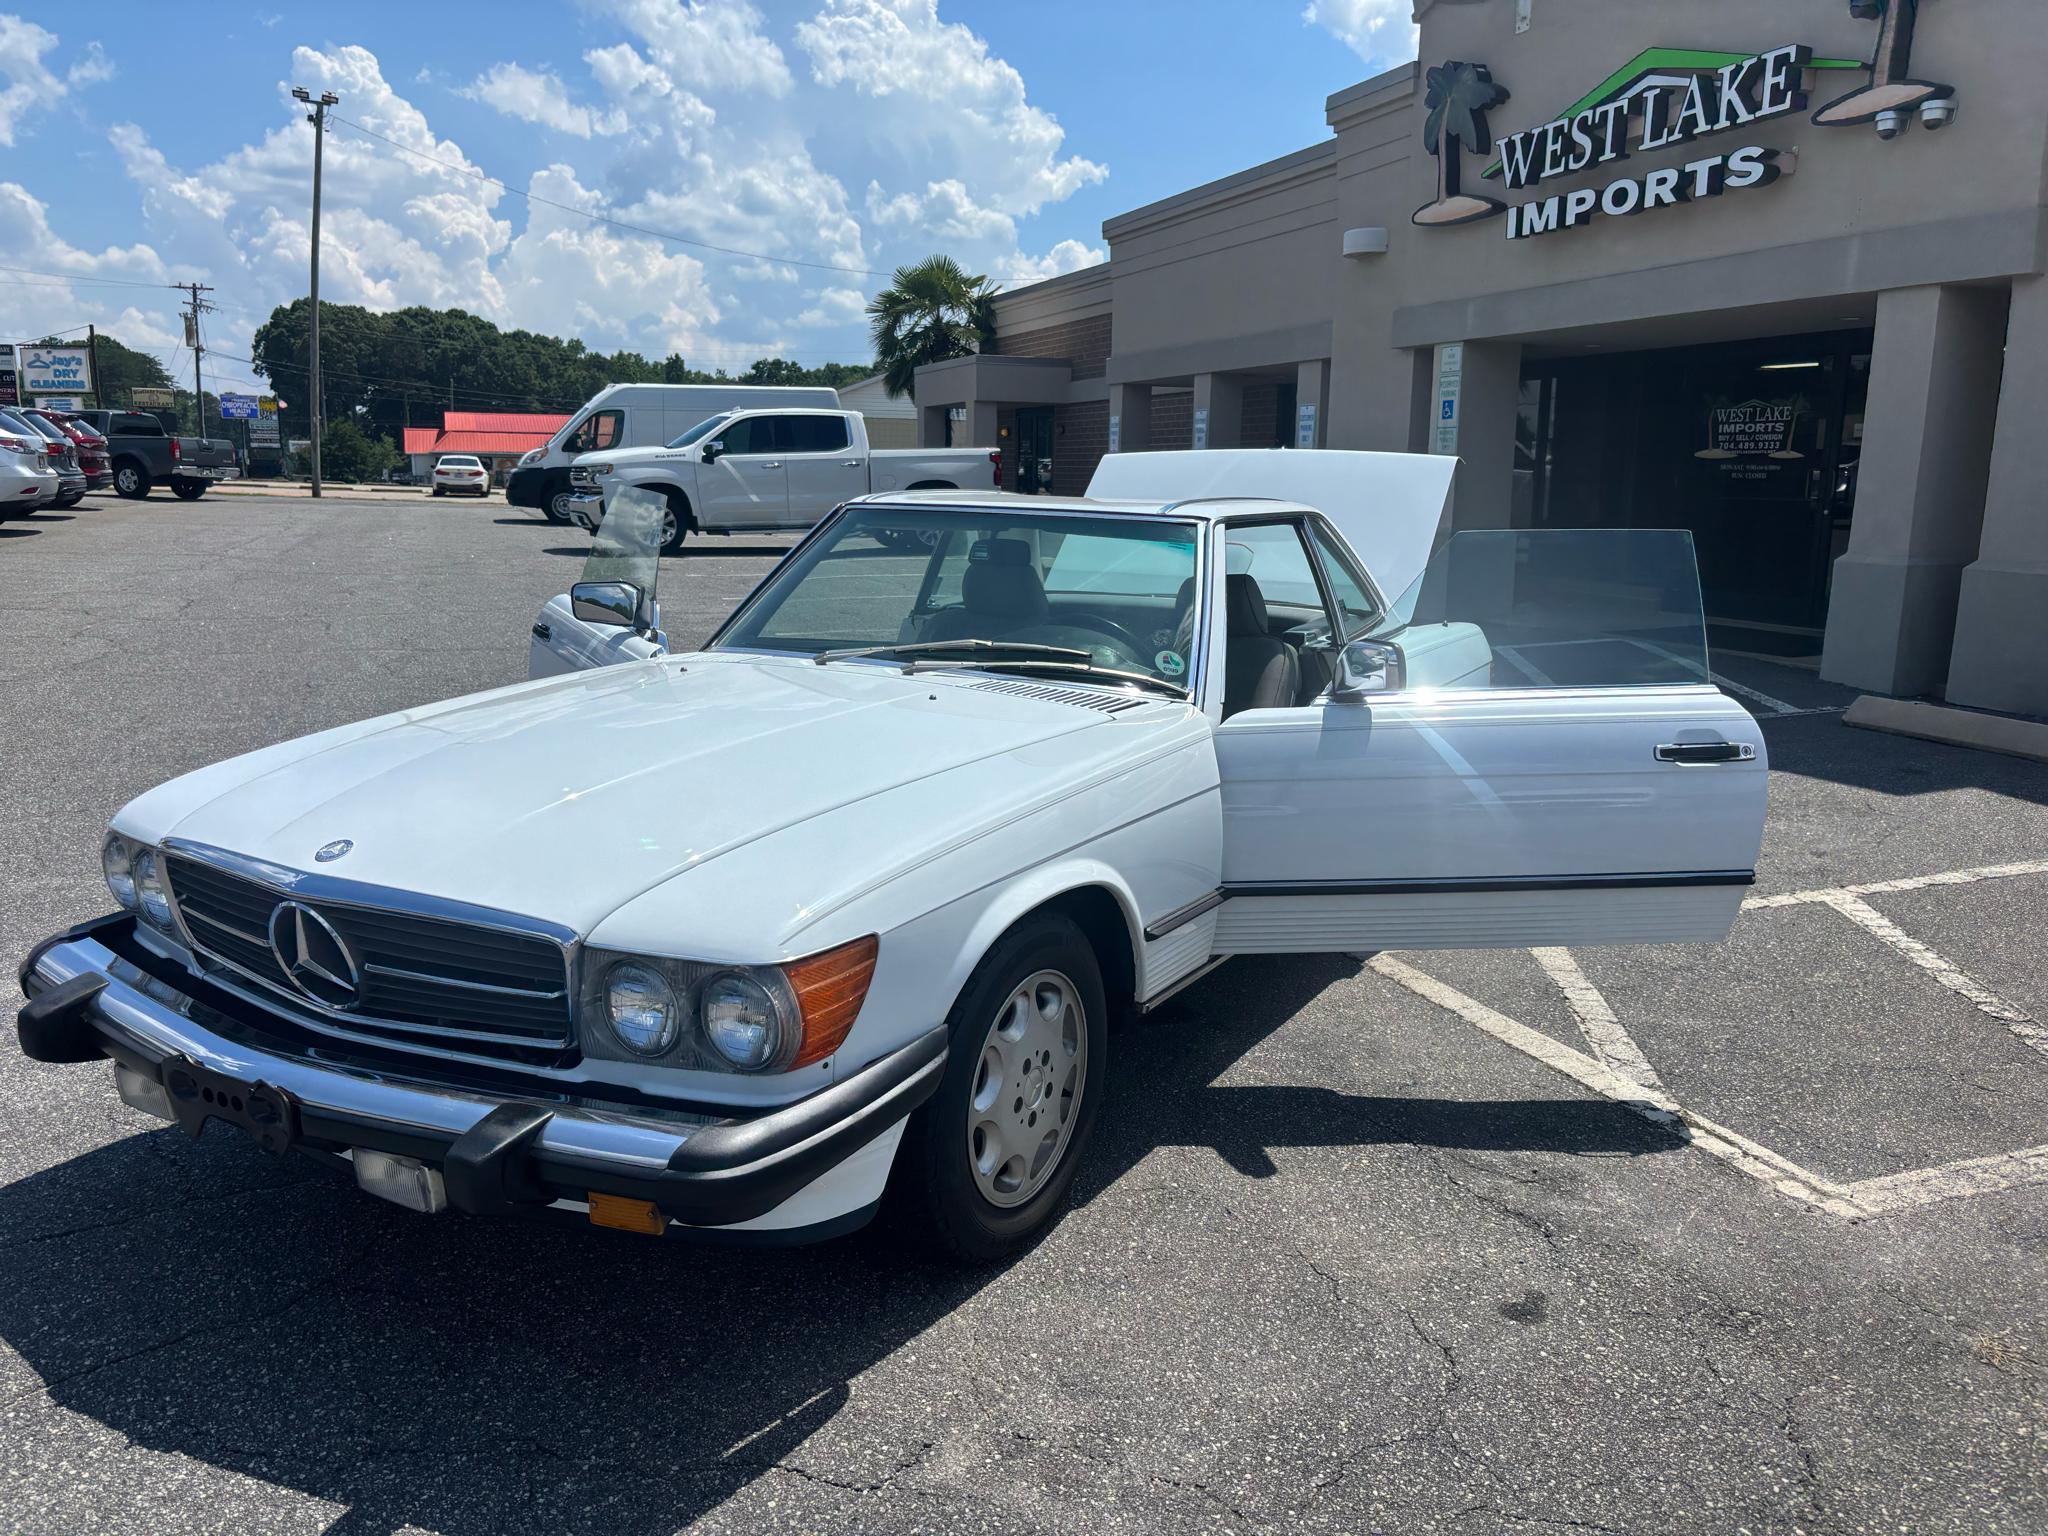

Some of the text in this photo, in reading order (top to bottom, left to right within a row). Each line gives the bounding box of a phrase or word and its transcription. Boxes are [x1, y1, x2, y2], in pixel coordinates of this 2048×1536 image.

[1495, 44, 1797, 190] WEST LAKE
[1506, 146, 1766, 240] IMPORTS
[49, 355, 82, 367] Jay's
[53, 368, 79, 378] DRY
[31, 379, 86, 389] CLEANERS
[221, 401, 258, 409] CHIROPRACTIC
[1716, 407, 1791, 422] WEST LAKE
[1719, 423, 1785, 433] IMPORTS
[1755, 433, 1783, 441] CONSIGN
[1719, 441, 1780, 449] 704.489.9333
